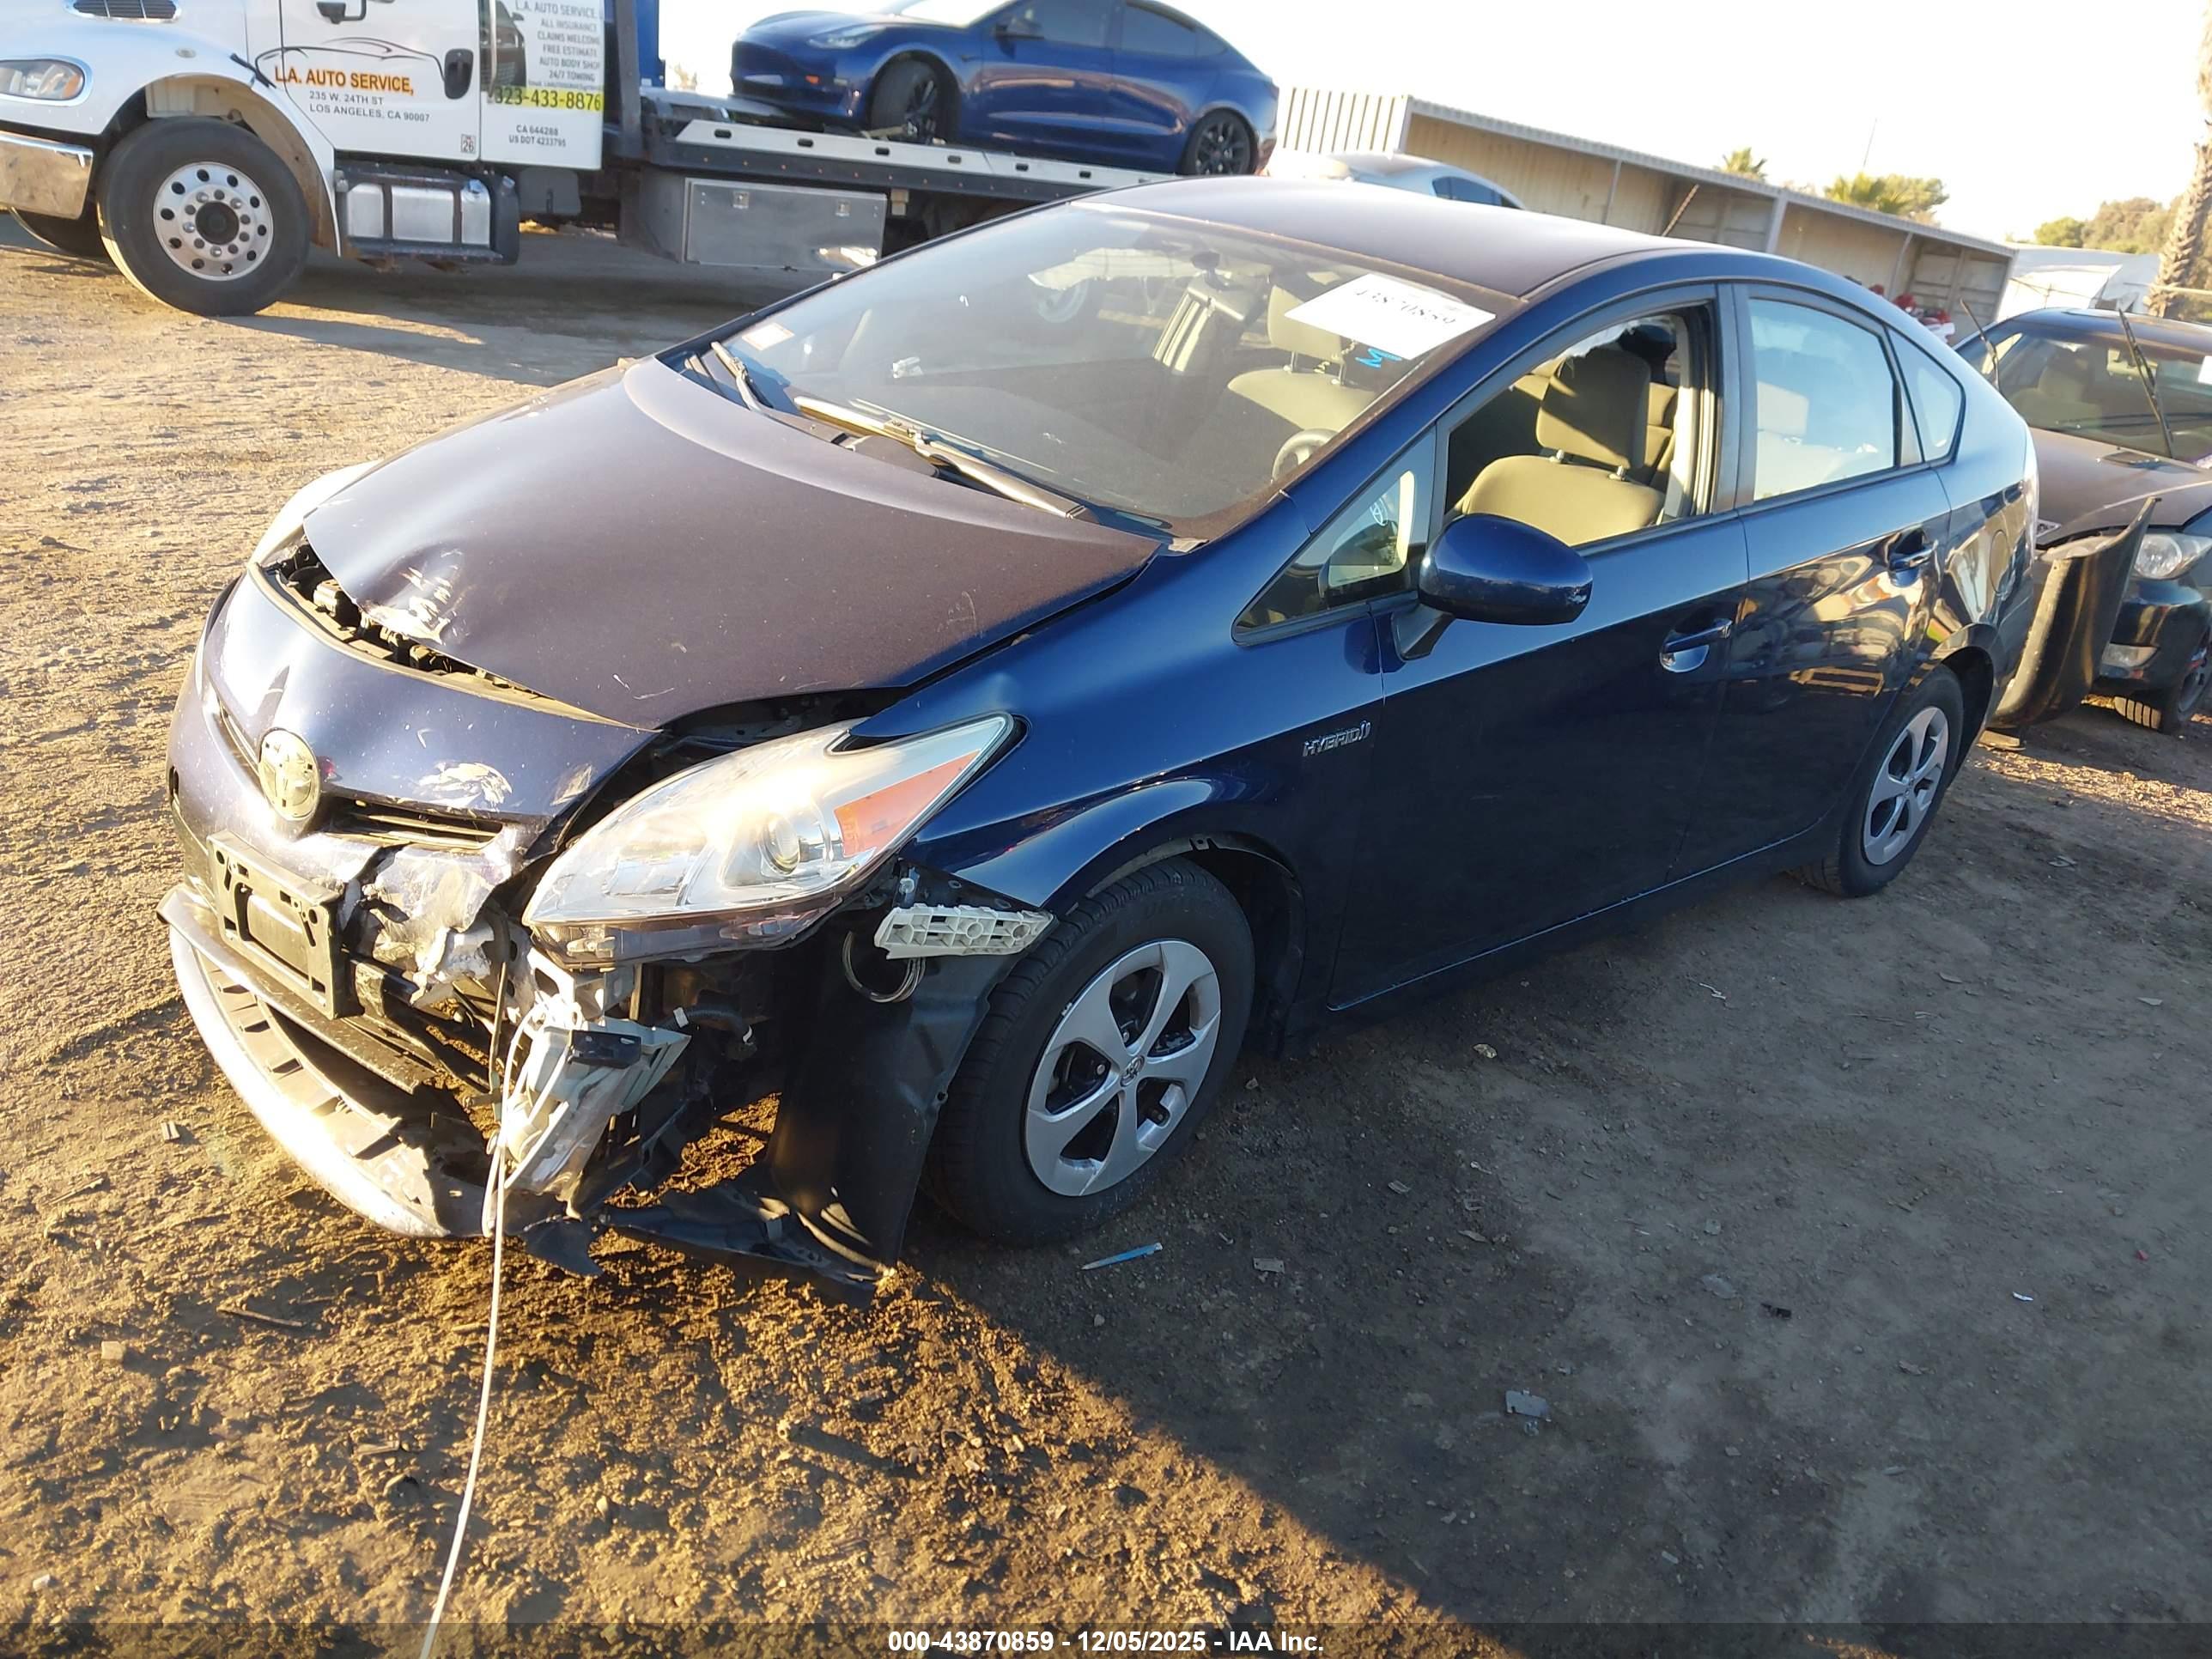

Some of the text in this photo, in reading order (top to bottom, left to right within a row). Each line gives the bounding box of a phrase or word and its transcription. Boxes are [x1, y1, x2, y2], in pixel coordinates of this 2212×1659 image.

[534, 2, 558, 14] AUTO
[537, 30, 564, 41] CLAIMS
[543, 44, 560, 54] FREE
[539, 57, 560, 67] AUTO
[562, 58, 580, 68] BODY
[275, 65, 414, 97] L.A. AUTO SERVICE,
[549, 70, 596, 82] 24/7 TOWING
[309, 90, 384, 105] 235 W. 24TH ST
[494, 86, 602, 111] 323-433-8876
[309, 104, 331, 113] LOS
[387, 110, 401, 119] CA
[403, 112, 430, 122] 90007
[516, 125, 527, 133] CA
[508, 135, 519, 143] US
[520, 136, 535, 144] DOT
